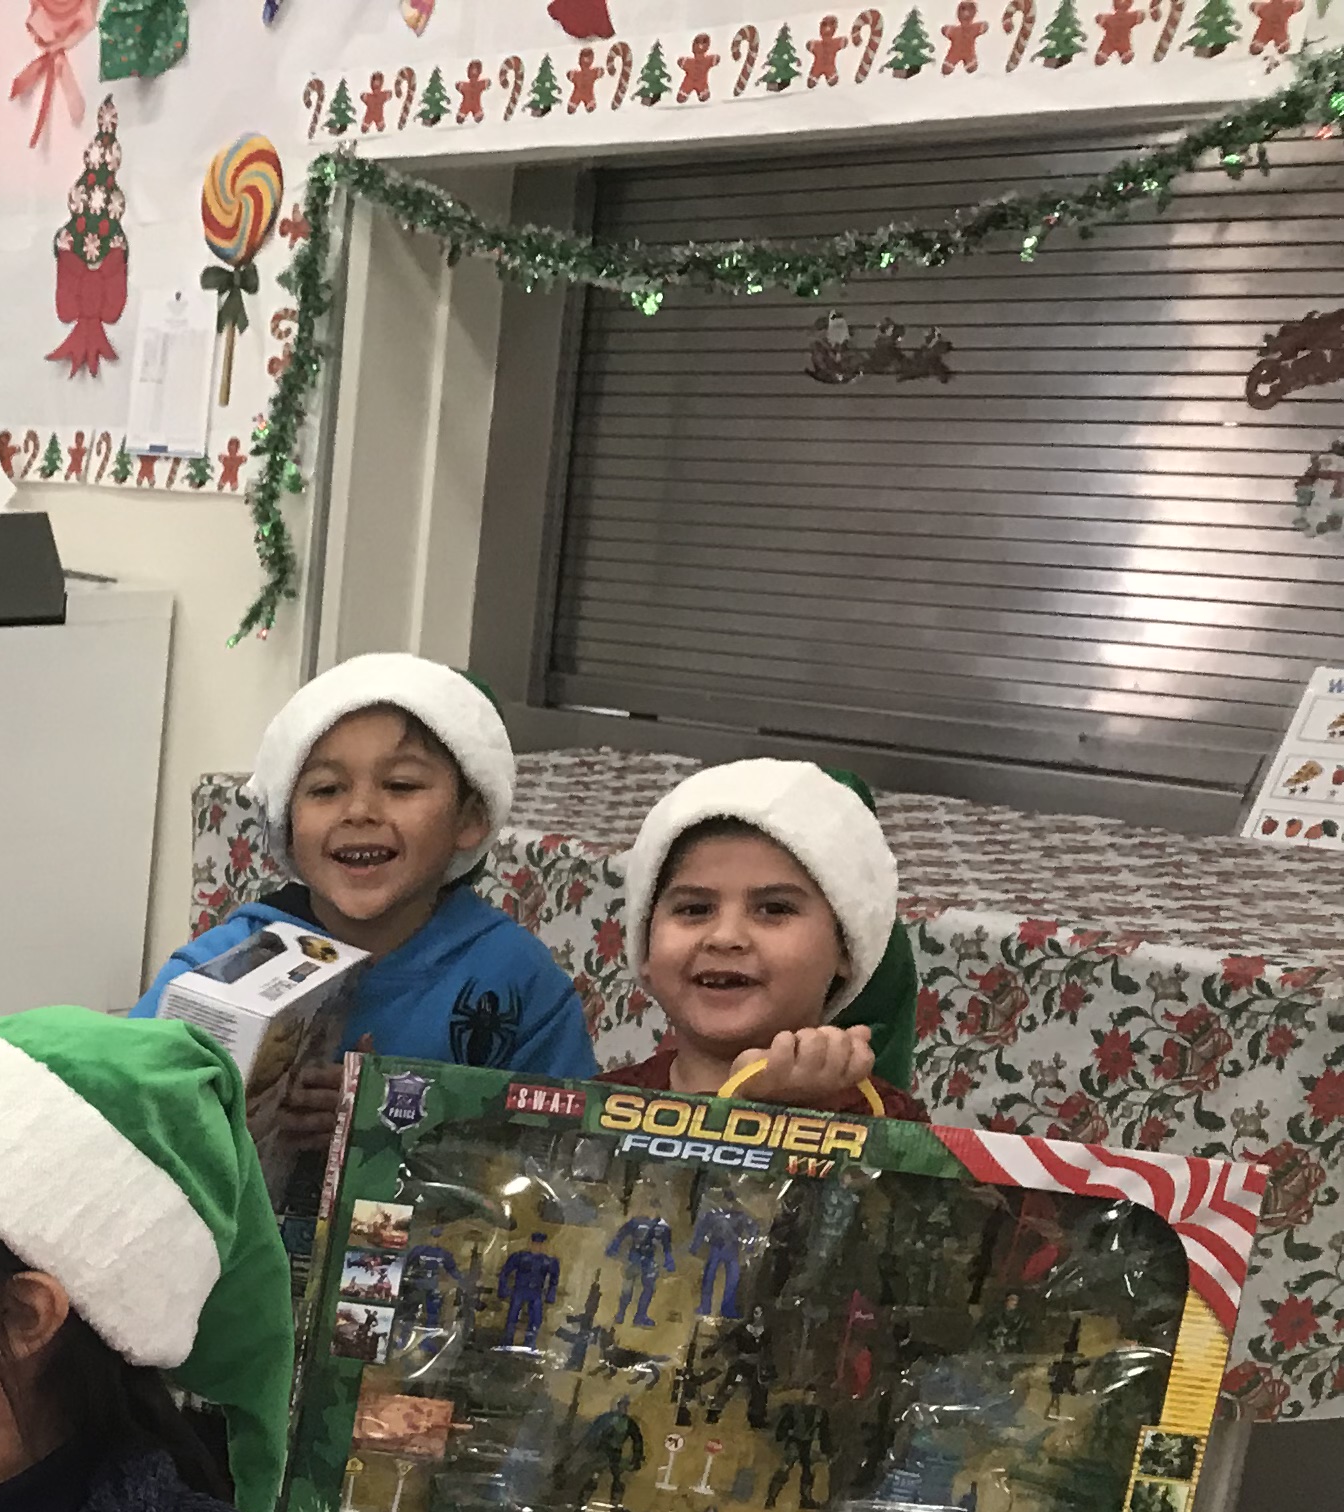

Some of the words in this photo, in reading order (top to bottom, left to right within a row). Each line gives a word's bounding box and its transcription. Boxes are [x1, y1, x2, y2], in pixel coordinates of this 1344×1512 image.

[388, 1107, 417, 1120] POLICE
[600, 1093, 868, 1159] SOLDIER
[621, 1133, 774, 1170] FORCE
